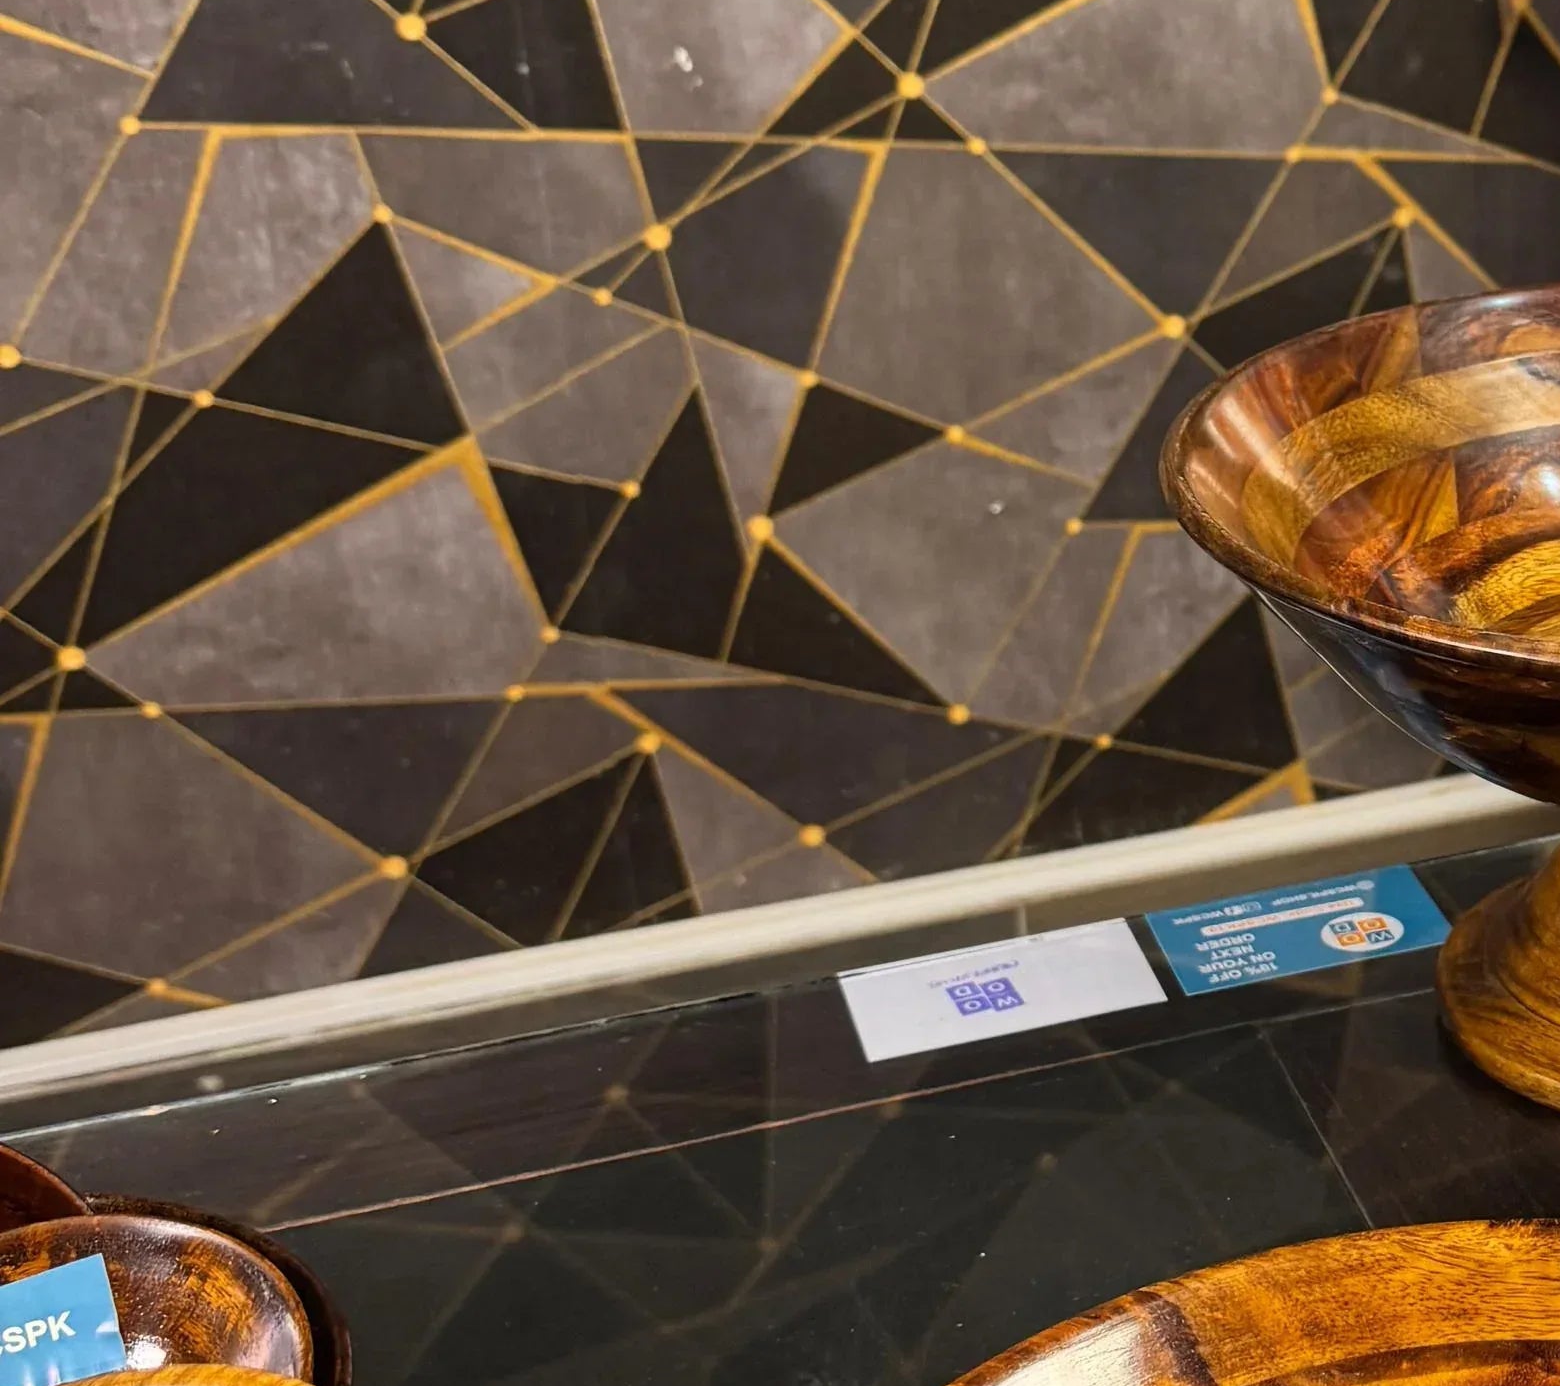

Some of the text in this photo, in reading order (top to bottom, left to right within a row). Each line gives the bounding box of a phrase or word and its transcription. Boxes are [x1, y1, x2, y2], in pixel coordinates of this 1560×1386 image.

[1194, 932, 1256, 952] ORDER
[1210, 943, 1255, 961] NEXT
[1197, 950, 1277, 974] ON YOUR
[1208, 969, 1243, 984] OFF
[0, 1310, 76, 1355] SPK
